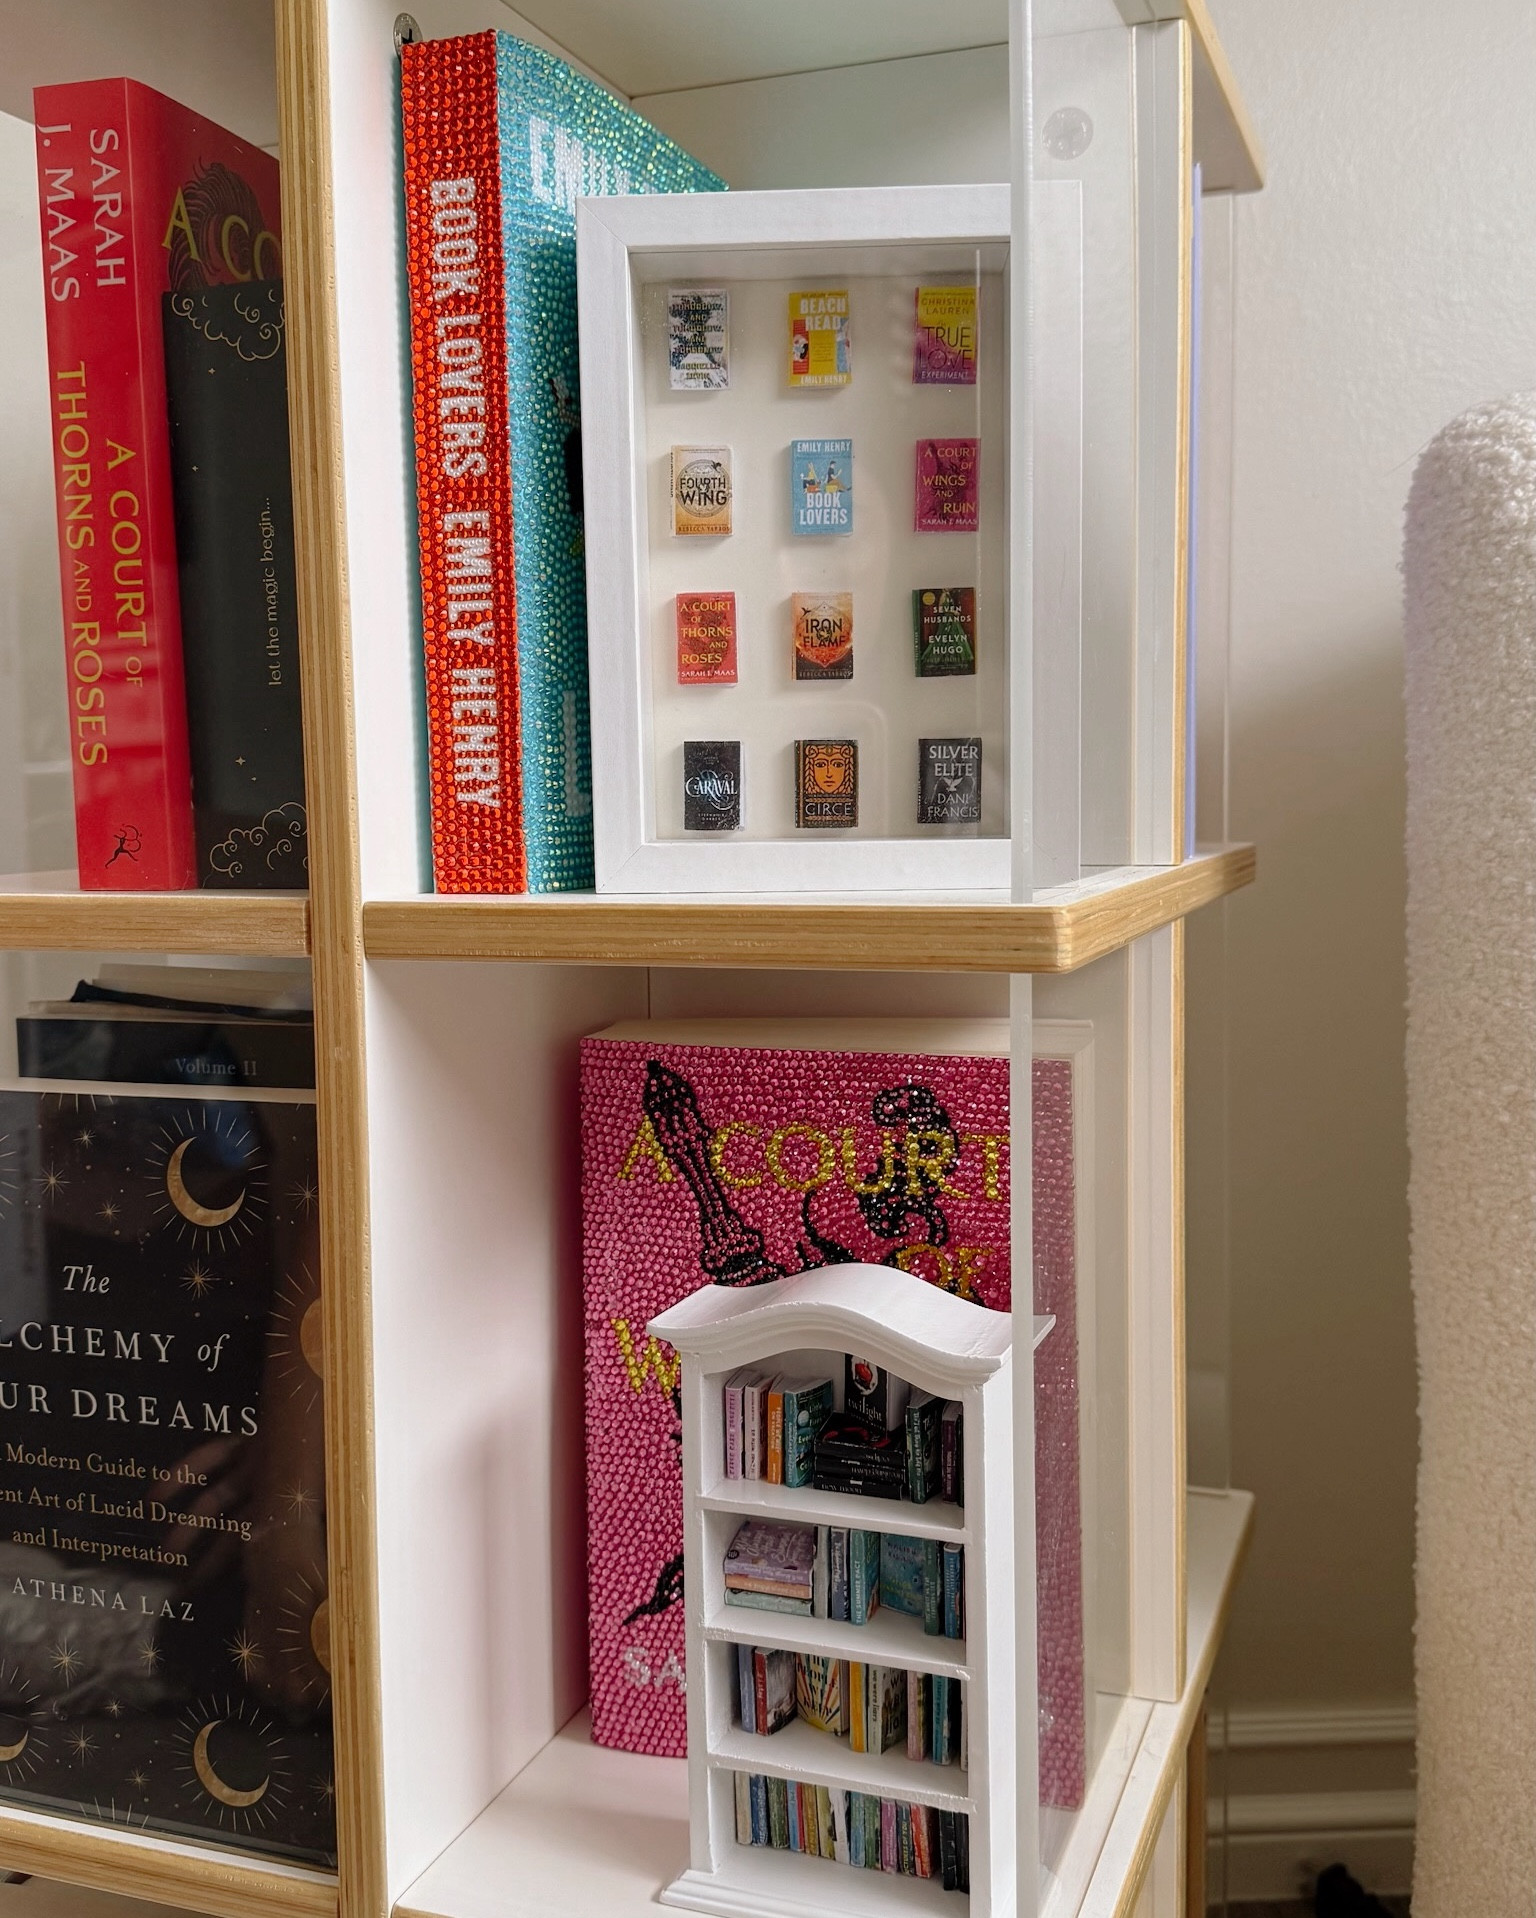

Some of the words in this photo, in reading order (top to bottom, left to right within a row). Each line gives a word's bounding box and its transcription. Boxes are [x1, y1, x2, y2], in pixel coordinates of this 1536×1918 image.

[37, 122, 73, 149] J.
[89, 128, 127, 287] SARAH
[161, 186, 201, 262] A
[44, 167, 81, 303] MAAS
[430, 176, 481, 300] BOOK
[799, 297, 846, 314] BEACH
[921, 298, 976, 306] CHRISTINA
[926, 307, 969, 315] LAUREN
[805, 315, 841, 331] READ
[921, 326, 971, 348] TRUE
[436, 314, 488, 478] LOVERS
[57, 361, 95, 550] THORNS
[106, 438, 137, 471] A
[797, 441, 822, 453] EMILY
[824, 441, 851, 452] HENRY
[924, 447, 933, 457] A
[937, 447, 977, 457] COURT
[680, 477, 726, 489] FOURTH
[922, 475, 966, 486] WINGS
[680, 490, 727, 506] WING
[806, 492, 842, 508] BOOK
[943, 502, 976, 514] RUIN
[800, 508, 848, 525] LOVERS
[109, 489, 147, 648] COURT
[443, 510, 495, 646] EMILY
[72, 559, 92, 612] AND
[262, 567, 279, 622] magic
[680, 603, 689, 612] A
[692, 601, 732, 612] COURT
[933, 605, 962, 613] SEVEN
[805, 618, 843, 634] IRON
[924, 615, 972, 624] HUSBANDS
[265, 625, 281, 657] the
[680, 626, 733, 638] THORNS
[928, 634, 967, 643] EVELYN
[681, 653, 722, 664] ROSES
[933, 646, 963, 654] HUGO
[126, 655, 144, 688] OF
[267, 661, 283, 687] let
[71, 621, 109, 767] ROSES
[451, 667, 501, 808] HENRY
[929, 745, 979, 759] SILVER
[934, 763, 973, 776] ELITE
[805, 802, 852, 815] CIRCE
[937, 793, 969, 804] DANI
[927, 806, 978, 817] FRANCIS
[175, 1057, 236, 1076] Volume
[617, 1114, 677, 1182] A
[711, 1122, 1010, 1200] COURT
[63, 1264, 110, 1294] The
[197, 1334, 230, 1372] of
[71, 1388, 259, 1437] DREAMS
[848, 1396, 882, 1422] twilight
[5, 1442, 81, 1471] Modern
[87, 1453, 147, 1480] Guide
[152, 1464, 171, 1483] to
[176, 1465, 208, 1487] the
[28, 1486, 61, 1509] Art
[66, 1492, 86, 1512] of
[90, 1493, 145, 1520] Lucid
[151, 1501, 252, 1541] Dreaming
[12, 1527, 46, 1546] and
[52, 1528, 189, 1567] Interpretation
[12, 1577, 127, 1611] ATHENA
[142, 1595, 195, 1622] LAZ
[855, 1611, 863, 1623] THE
